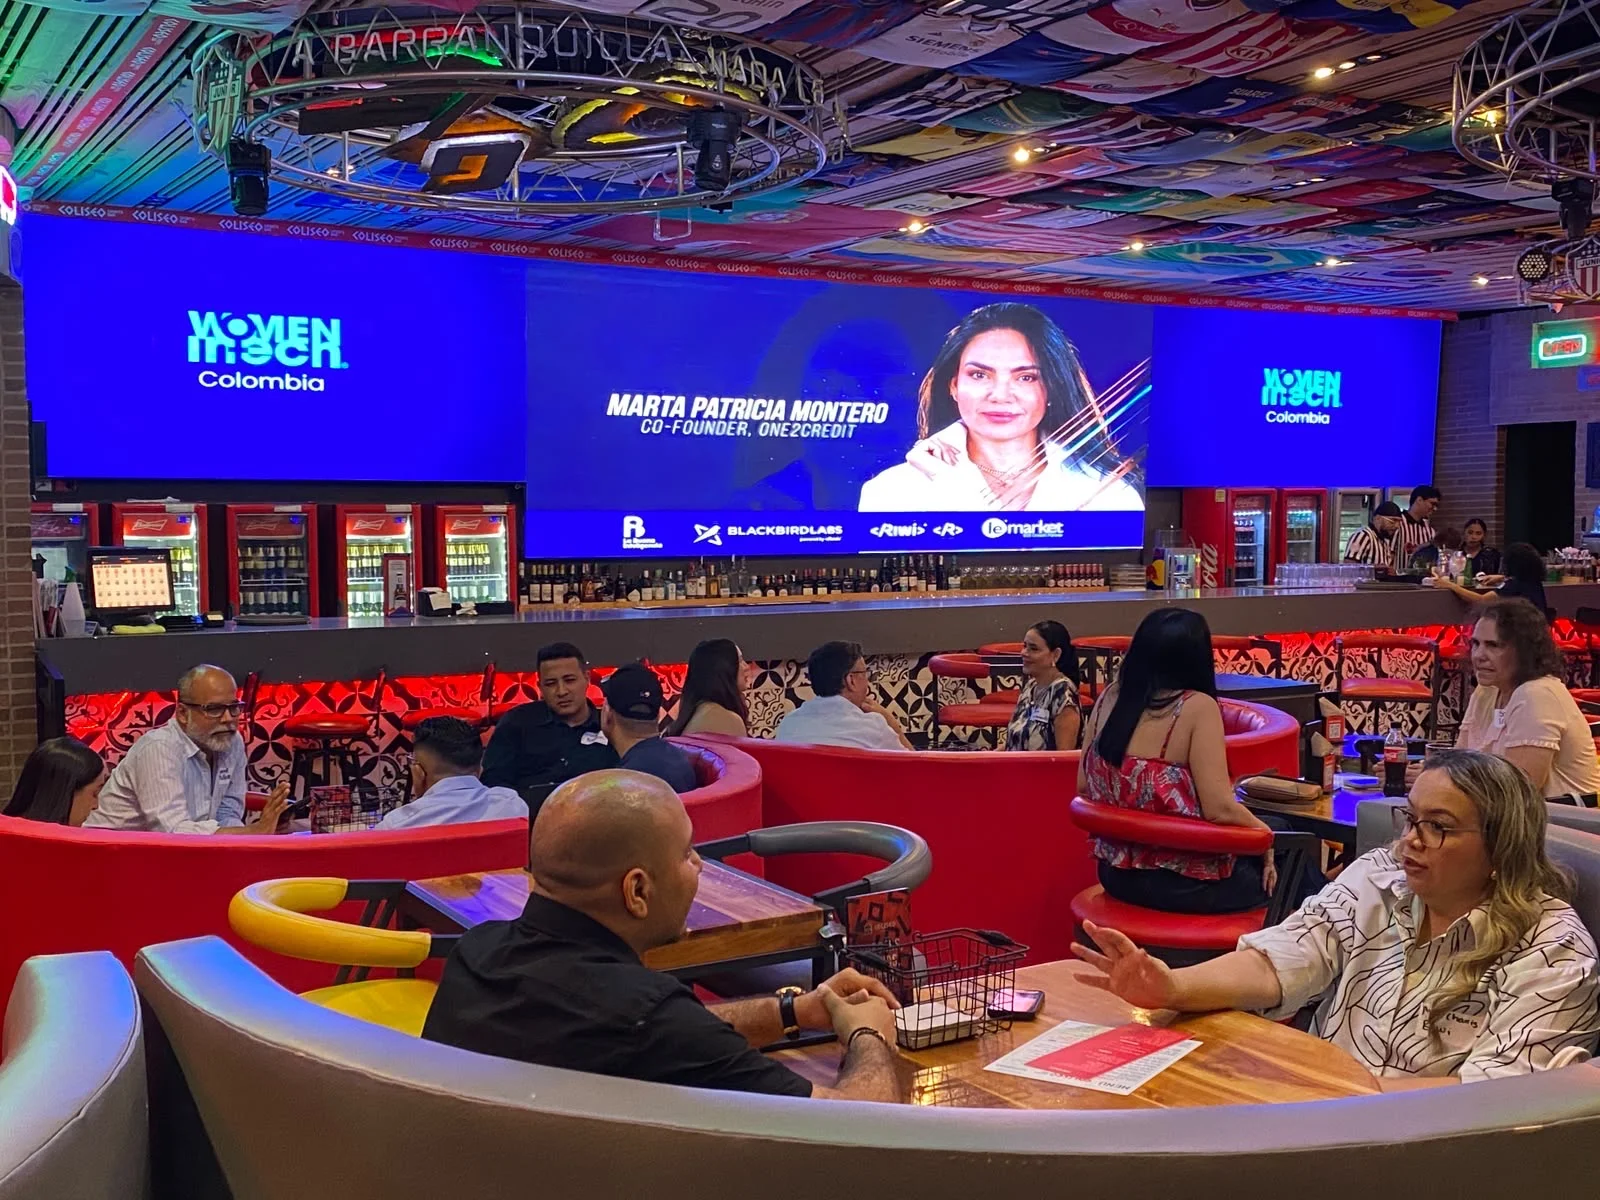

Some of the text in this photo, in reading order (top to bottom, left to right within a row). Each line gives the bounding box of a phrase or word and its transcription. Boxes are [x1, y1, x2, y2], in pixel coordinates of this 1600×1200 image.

[1233, 48, 1263, 59] KIA
[58, 205, 106, 218] COLISEO
[132, 210, 178, 224] COLISEO
[219, 219, 263, 232] COLISEO
[287, 224, 330, 237] COLISEO
[352, 230, 394, 243] COLISEO
[429, 237, 469, 249] COLISEO
[489, 242, 528, 254] COLISEO
[198, 370, 325, 392] Colombia
[606, 393, 889, 424] MARTA PATRICIA MONTERO
[1265, 410, 1331, 425] Colombia
[640, 418, 858, 439] CO-FOUNDER, ONE2CREDIT
[727, 525, 843, 537] BLACKBIRDLABS
[1201, 542, 1218, 591] ola
